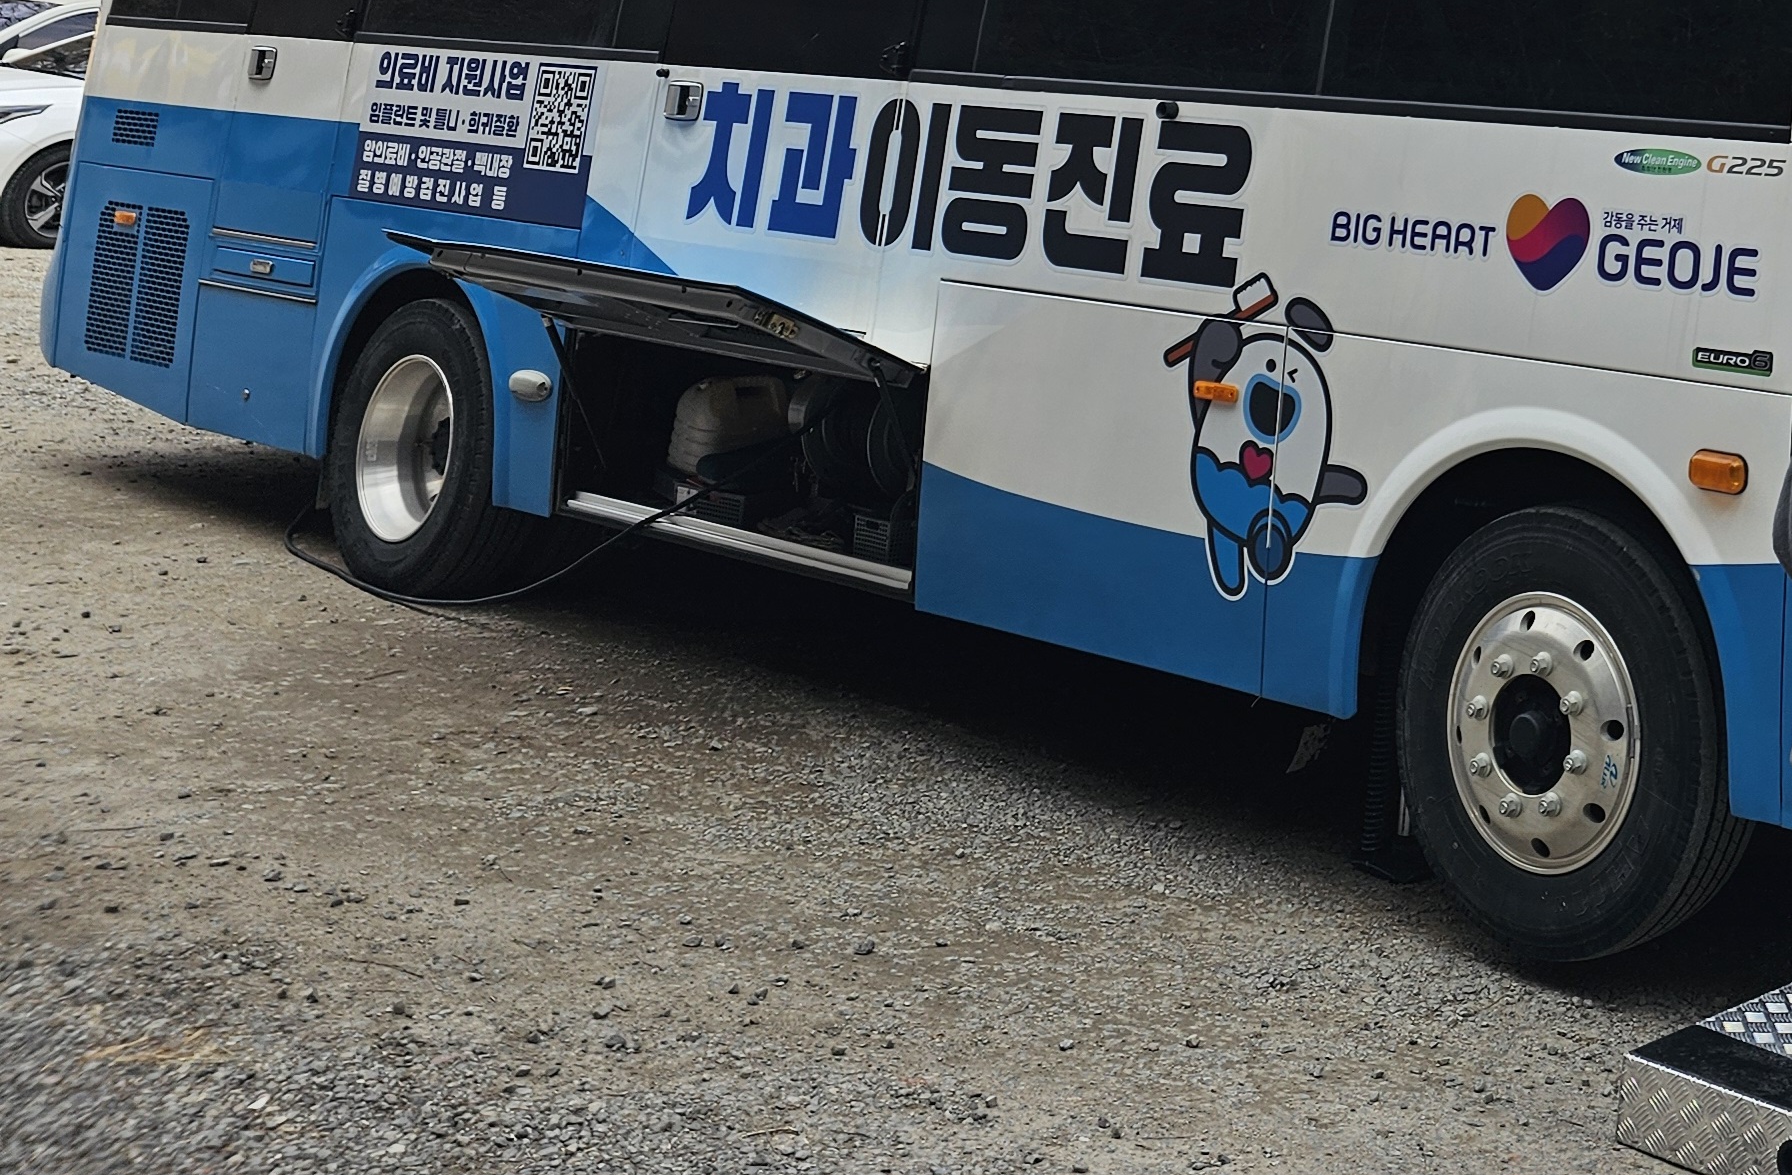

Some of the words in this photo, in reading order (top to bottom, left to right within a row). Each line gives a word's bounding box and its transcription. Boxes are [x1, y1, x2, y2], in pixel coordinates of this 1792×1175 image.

[375, 51, 440, 93] 의료비
[440, 56, 530, 101] 지원사업
[369, 101, 418, 127] 임플란트
[419, 107, 433, 129] 및
[1621, 153, 1642, 165] New
[1642, 153, 1666, 165] Clean
[1666, 155, 1697, 169] Engine
[1707, 155, 1787, 177] G225
[491, 186, 507, 210] 등
[1330, 211, 1382, 246] BIG
[1388, 216, 1496, 257] HEART
[1602, 211, 1635, 229] 감동을
[1637, 214, 1659, 232] 주는
[1661, 216, 1683, 235] 거제
[1598, 234, 1759, 297] GEOJE
